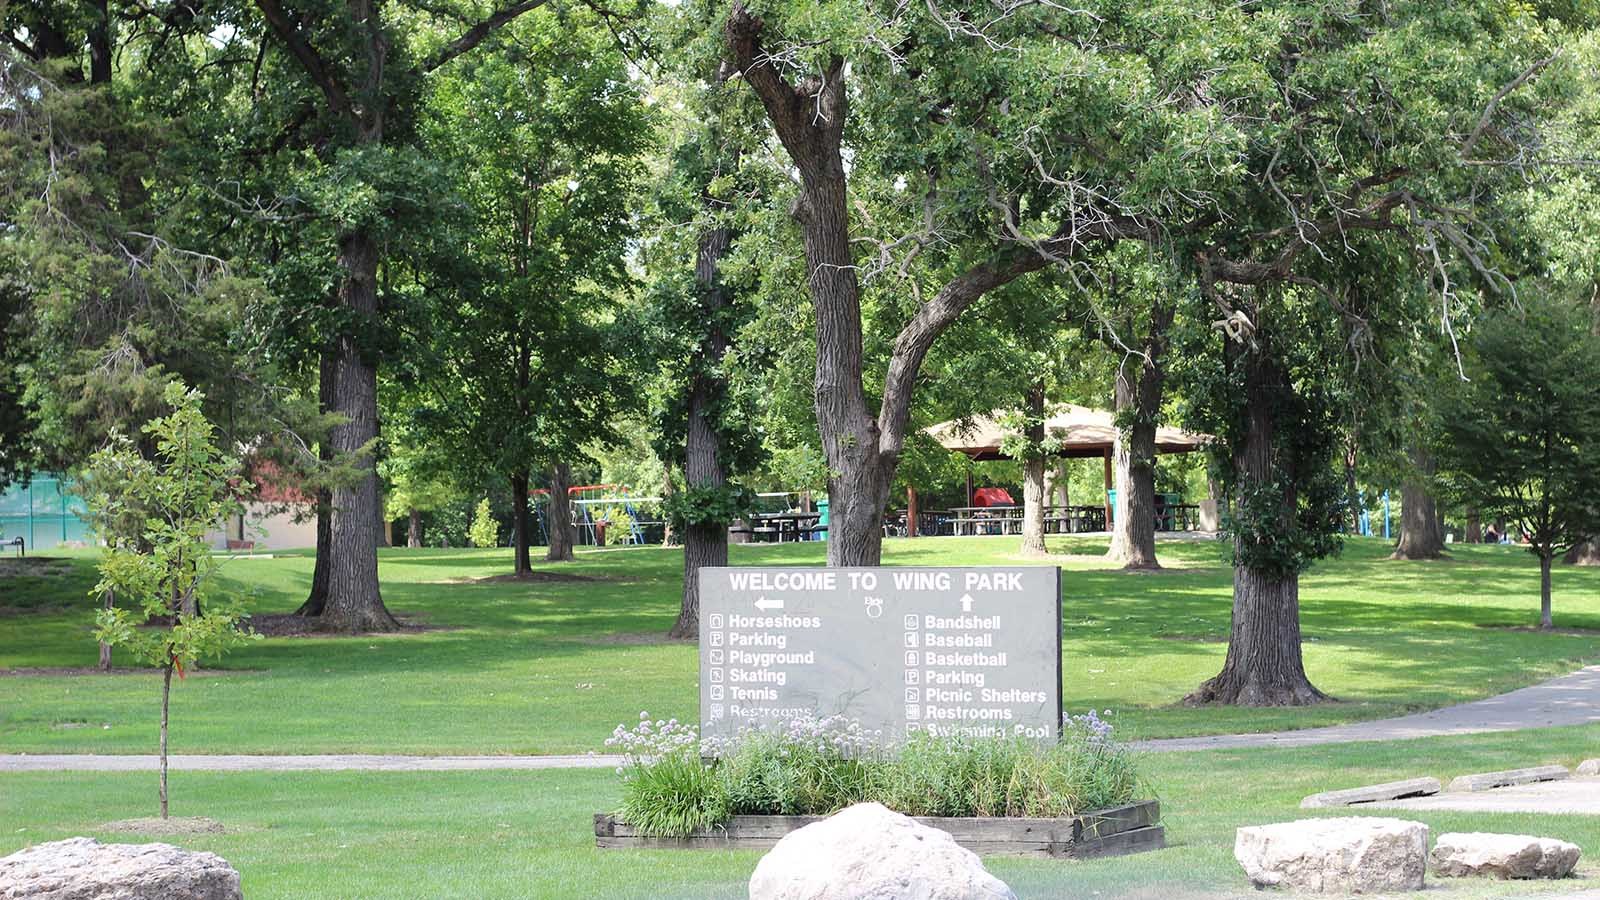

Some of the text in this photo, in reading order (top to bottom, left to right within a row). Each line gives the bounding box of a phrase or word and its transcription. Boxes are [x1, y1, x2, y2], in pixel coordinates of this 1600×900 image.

[729, 572, 1024, 591] WELCOME TO WING PARK
[729, 614, 821, 628] Horseshoes
[925, 616, 1000, 629] Bandshell
[729, 632, 786, 648] Parking
[925, 634, 992, 647] Baseball
[730, 650, 814, 667] Playground
[926, 652, 1007, 666] Basketball
[730, 668, 786, 685] Skating
[926, 671, 984, 687] Parking
[730, 686, 777, 700] Tennis
[926, 688, 1047, 702] Picnic Shelters
[730, 703, 813, 718] Restrooms
[926, 705, 1012, 720] Restrooms
